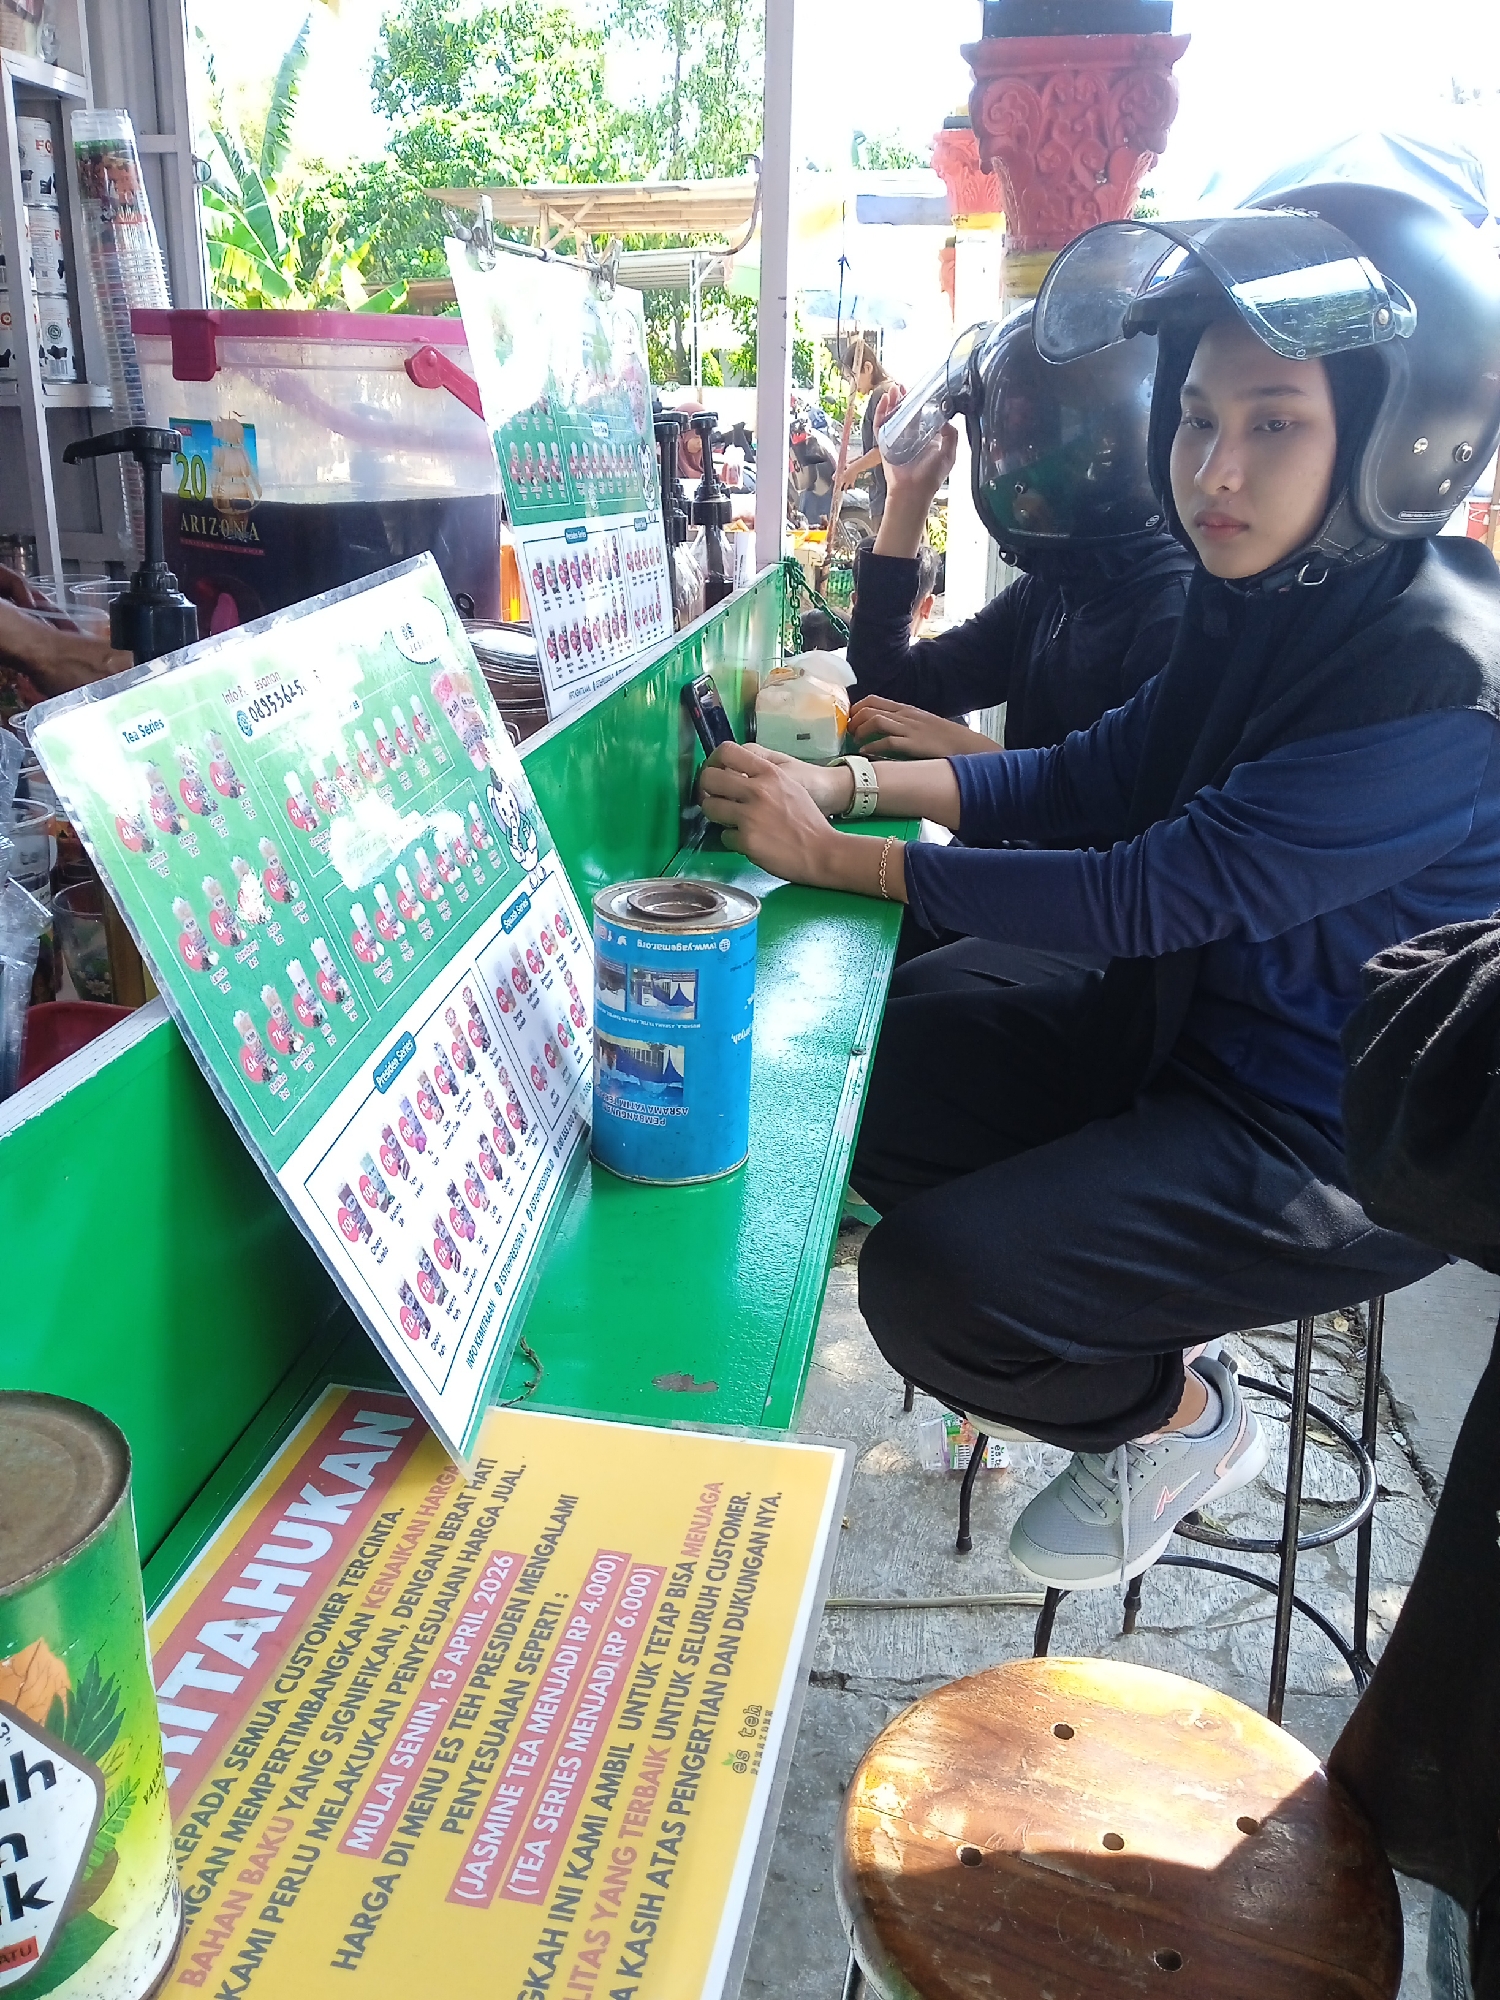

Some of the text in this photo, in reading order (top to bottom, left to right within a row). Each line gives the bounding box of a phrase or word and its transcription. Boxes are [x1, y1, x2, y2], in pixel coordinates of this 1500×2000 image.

[175, 452, 207, 501] 20
[181, 512, 260, 541] ARIZONA
[122, 718, 165, 744] Tea Series
[376, 1039, 414, 1087] Presiden Series
[618, 1099, 689, 1117] ASRAMA YATIM
[466, 1341, 482, 1369] INFO
[681, 1482, 724, 1558] MENJAGA
[754, 1491, 783, 1529] NYA.
[665, 1560, 698, 1599] BISA
[722, 1531, 771, 1632] DUKUNGAN
[220, 1613, 375, 1843] MEMPERTIMBANGKAN
[361, 1519, 430, 1609] KENAIKAN
[416, 1463, 462, 1518] HARGA
[224, 1699, 288, 1771] SEMUA
[275, 1592, 353, 1694] CUSTOMER
[337, 1507, 405, 1587] TERCINTA.
[643, 1602, 681, 1657] TETAP
[709, 1634, 741, 1677] DAN
[177, 1457, 498, 1987] BAHAN BAKU YANG SIGNIFIKAN, DENGAN BERAT HATI
[346, 1555, 514, 1851] MULAI SENIN, 13 APRIL 2026
[440, 1679, 530, 1834] PENYESUAIAN
[514, 1601, 564, 1676] SEPERTI
[454, 1554, 625, 1899] (JASMINE TEA MENJADI RP 4.000)
[590, 1845, 637, 1922] YANG
[618, 1744, 671, 1838] TERBAIK
[651, 1669, 696, 1741] UNTUK
[677, 1584, 722, 1667] SELURUH
[705, 1491, 752, 1582] CUSTOMER.
[617, 1660, 663, 1730] UNTUK
[738, 1704, 762, 1738] teh
[214, 1463, 527, 2000] KAMI PERLU MELAKUKAN PENYESUAIAN HARGA JUAL.
[330, 1493, 579, 1970] HARGA DI MENU ES TEH PRESIDEN MENGALAMI
[506, 1567, 660, 1896] (TEA SERIES MENJADI RP 6.000)
[666, 1680, 728, 1816] PENGERTIAN
[732, 1749, 750, 1773] es
[591, 1742, 634, 1811] AMBIL
[563, 1814, 609, 1881] KAMI
[646, 1820, 686, 1889] ATAS
[547, 1885, 584, 1923] INI
[616, 1892, 666, 1978] KASIH
